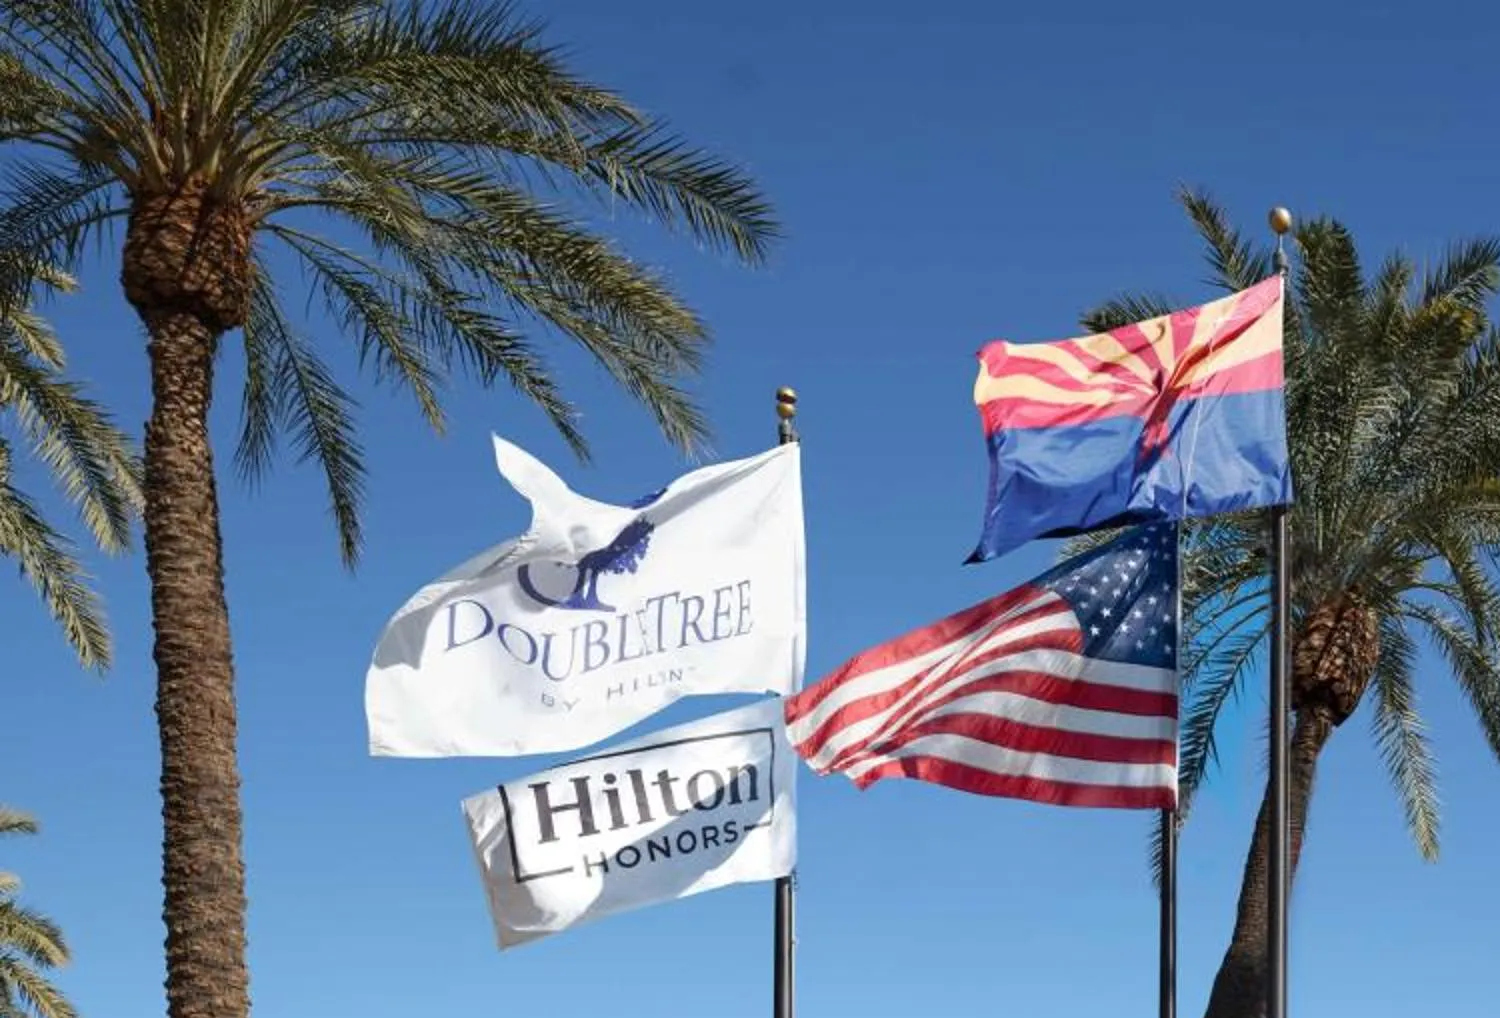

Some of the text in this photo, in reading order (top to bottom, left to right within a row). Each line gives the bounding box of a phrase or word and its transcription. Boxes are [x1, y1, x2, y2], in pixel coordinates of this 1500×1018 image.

[444, 579, 754, 683] DOUBLETREE
[541, 692, 581, 712] BY
[528, 759, 760, 845] Hilton
[583, 820, 739, 878] HONORS
